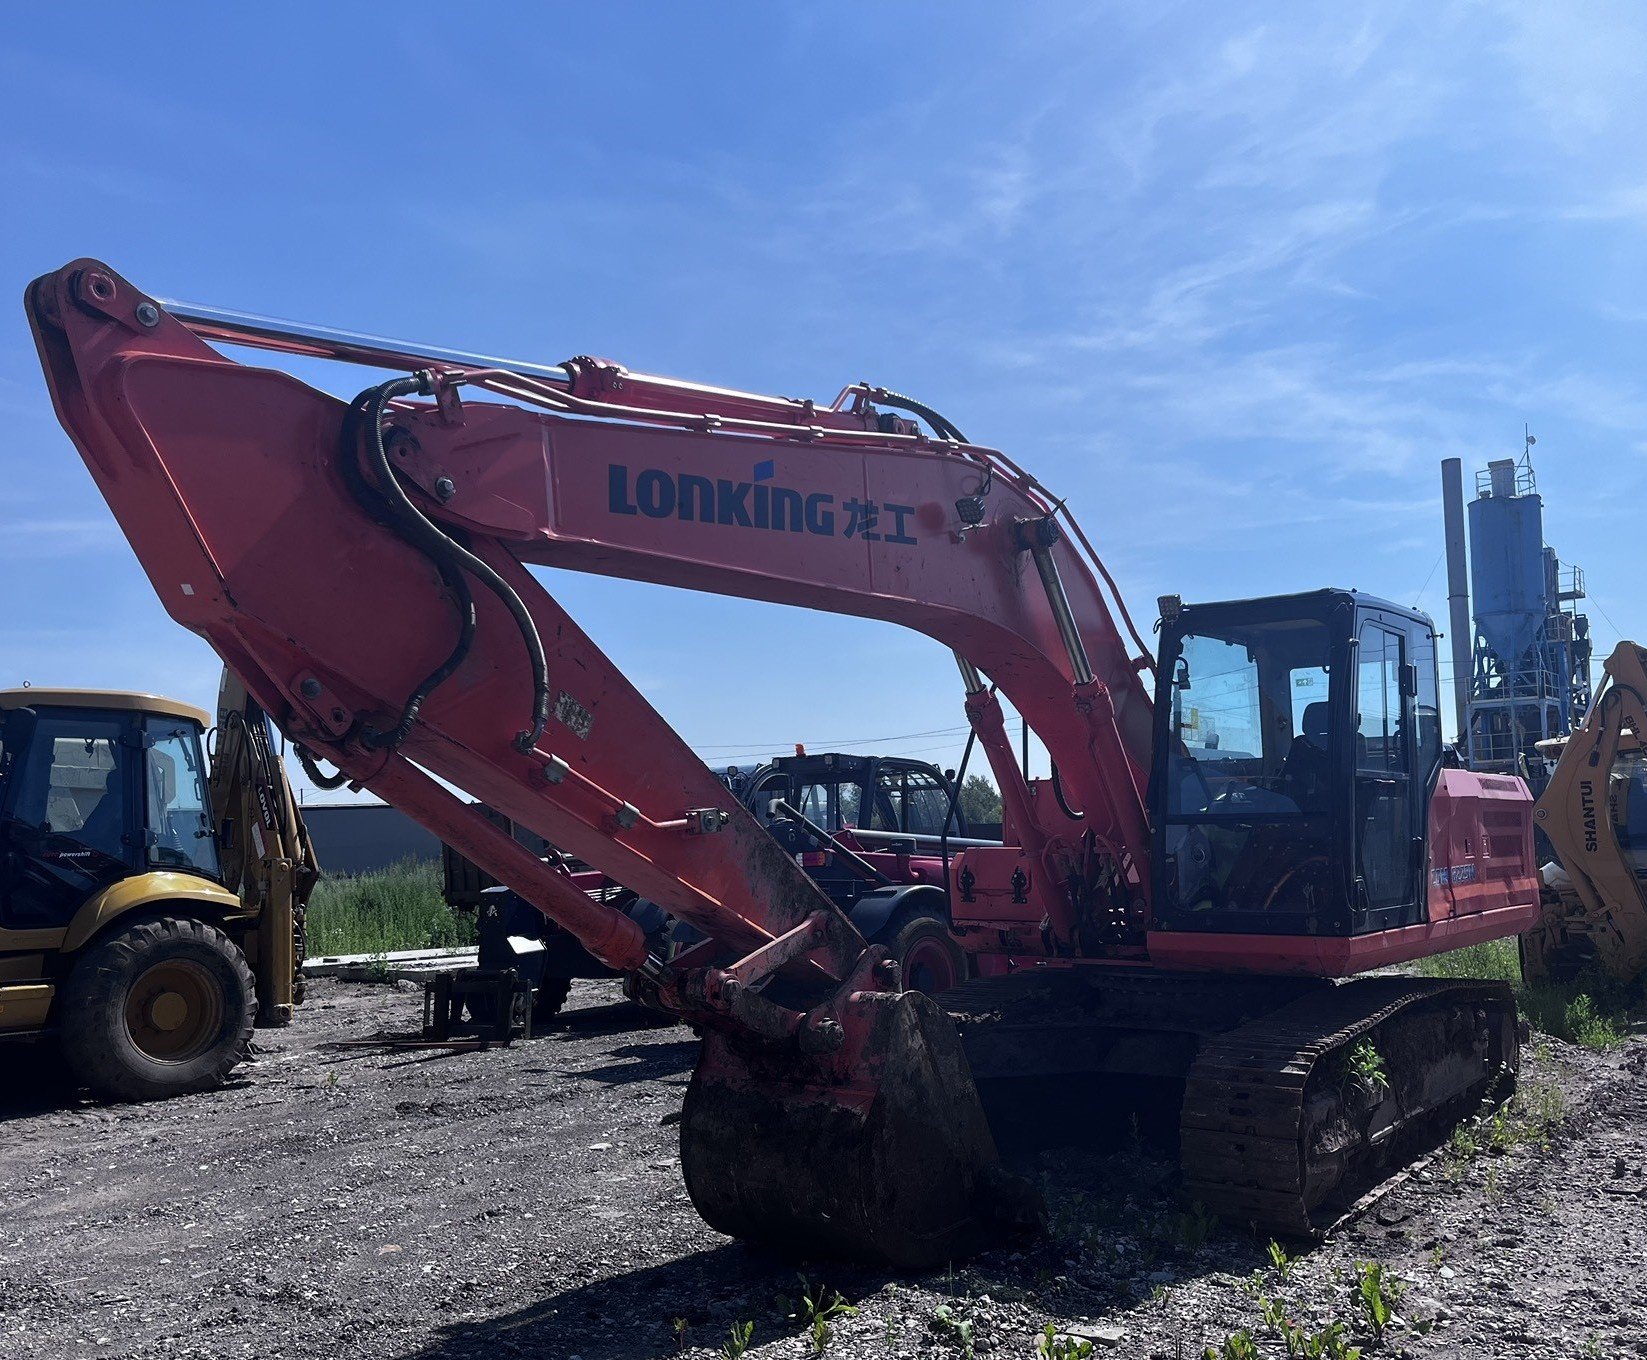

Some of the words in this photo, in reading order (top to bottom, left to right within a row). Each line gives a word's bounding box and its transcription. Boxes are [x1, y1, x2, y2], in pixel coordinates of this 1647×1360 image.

[843, 497, 918, 545] 龙工
[257, 786, 271, 829] LOVOL
[1580, 781, 1598, 853] SHANTUI
